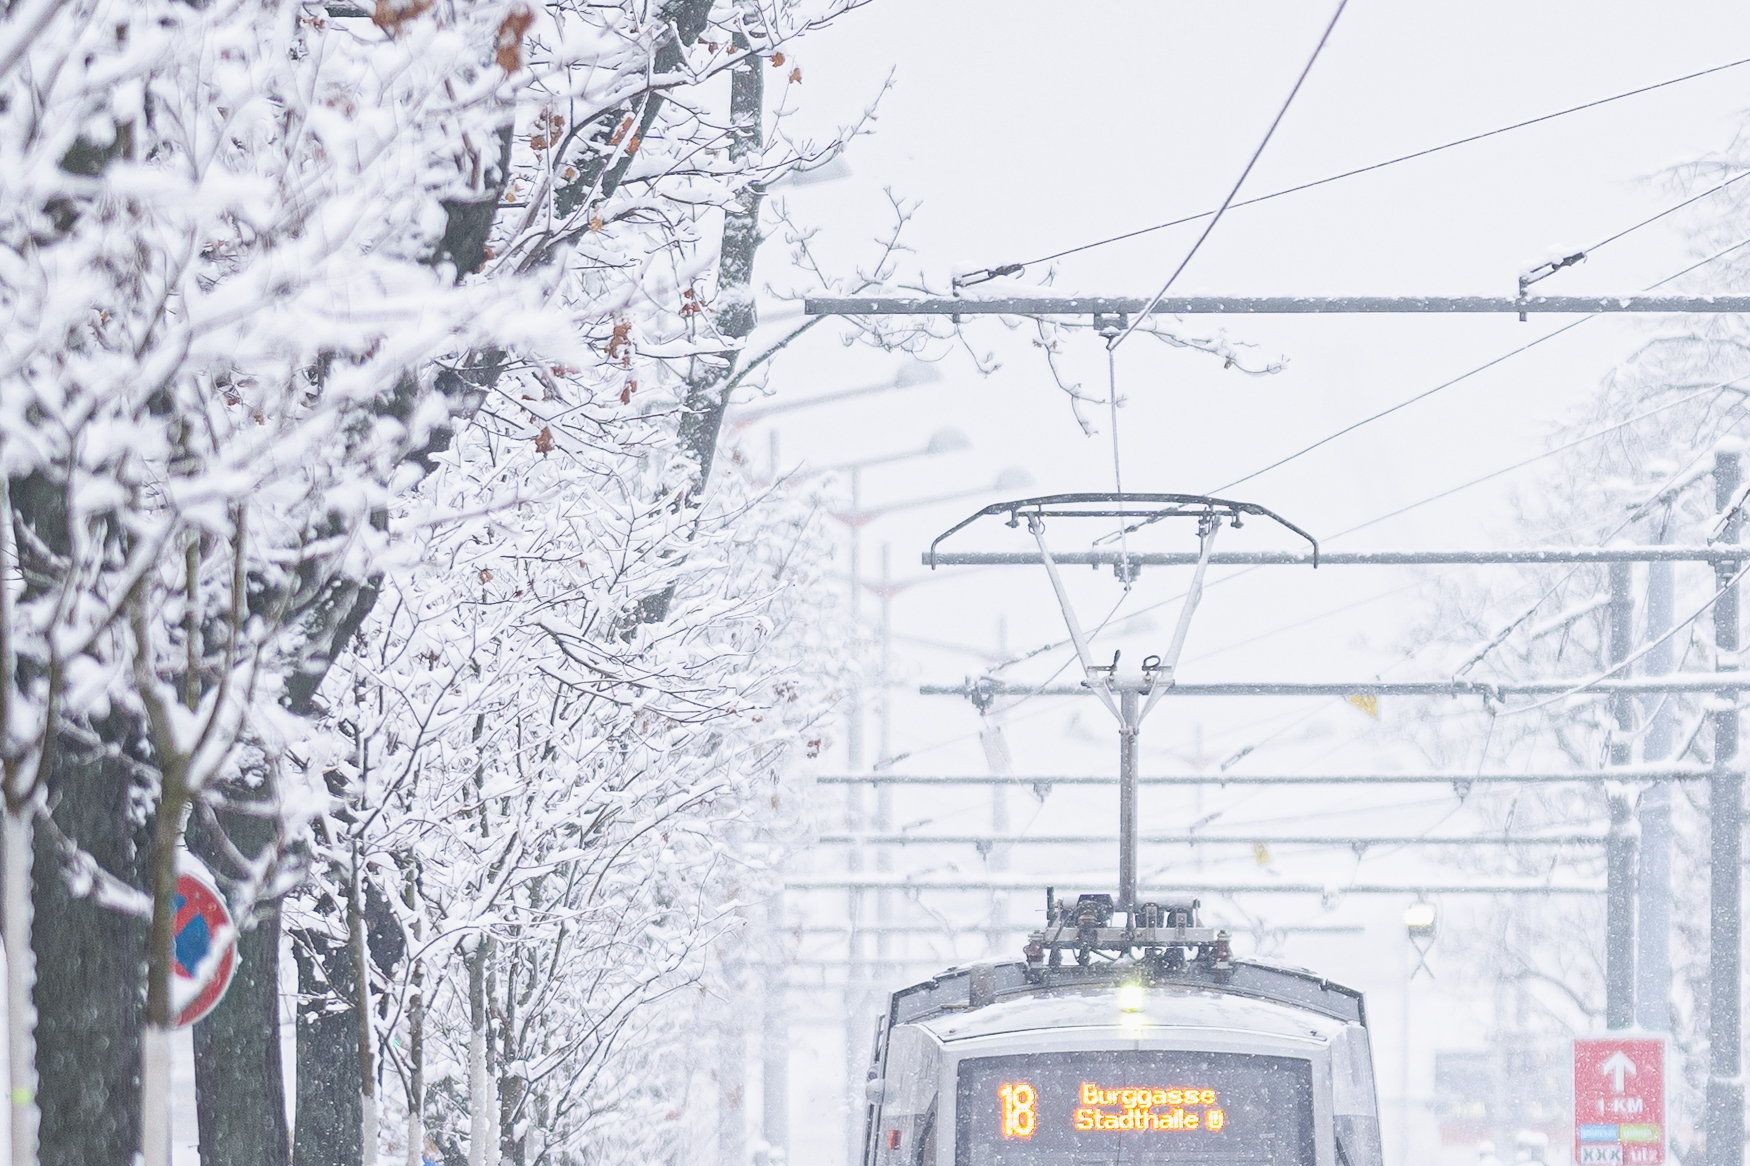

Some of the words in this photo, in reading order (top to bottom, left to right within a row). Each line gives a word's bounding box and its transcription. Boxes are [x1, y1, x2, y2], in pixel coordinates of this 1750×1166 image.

[999, 1082, 1036, 1136] 18
[1081, 1083, 1217, 1109] Burggasse
[1075, 1108, 1199, 1130] Stadthalle
